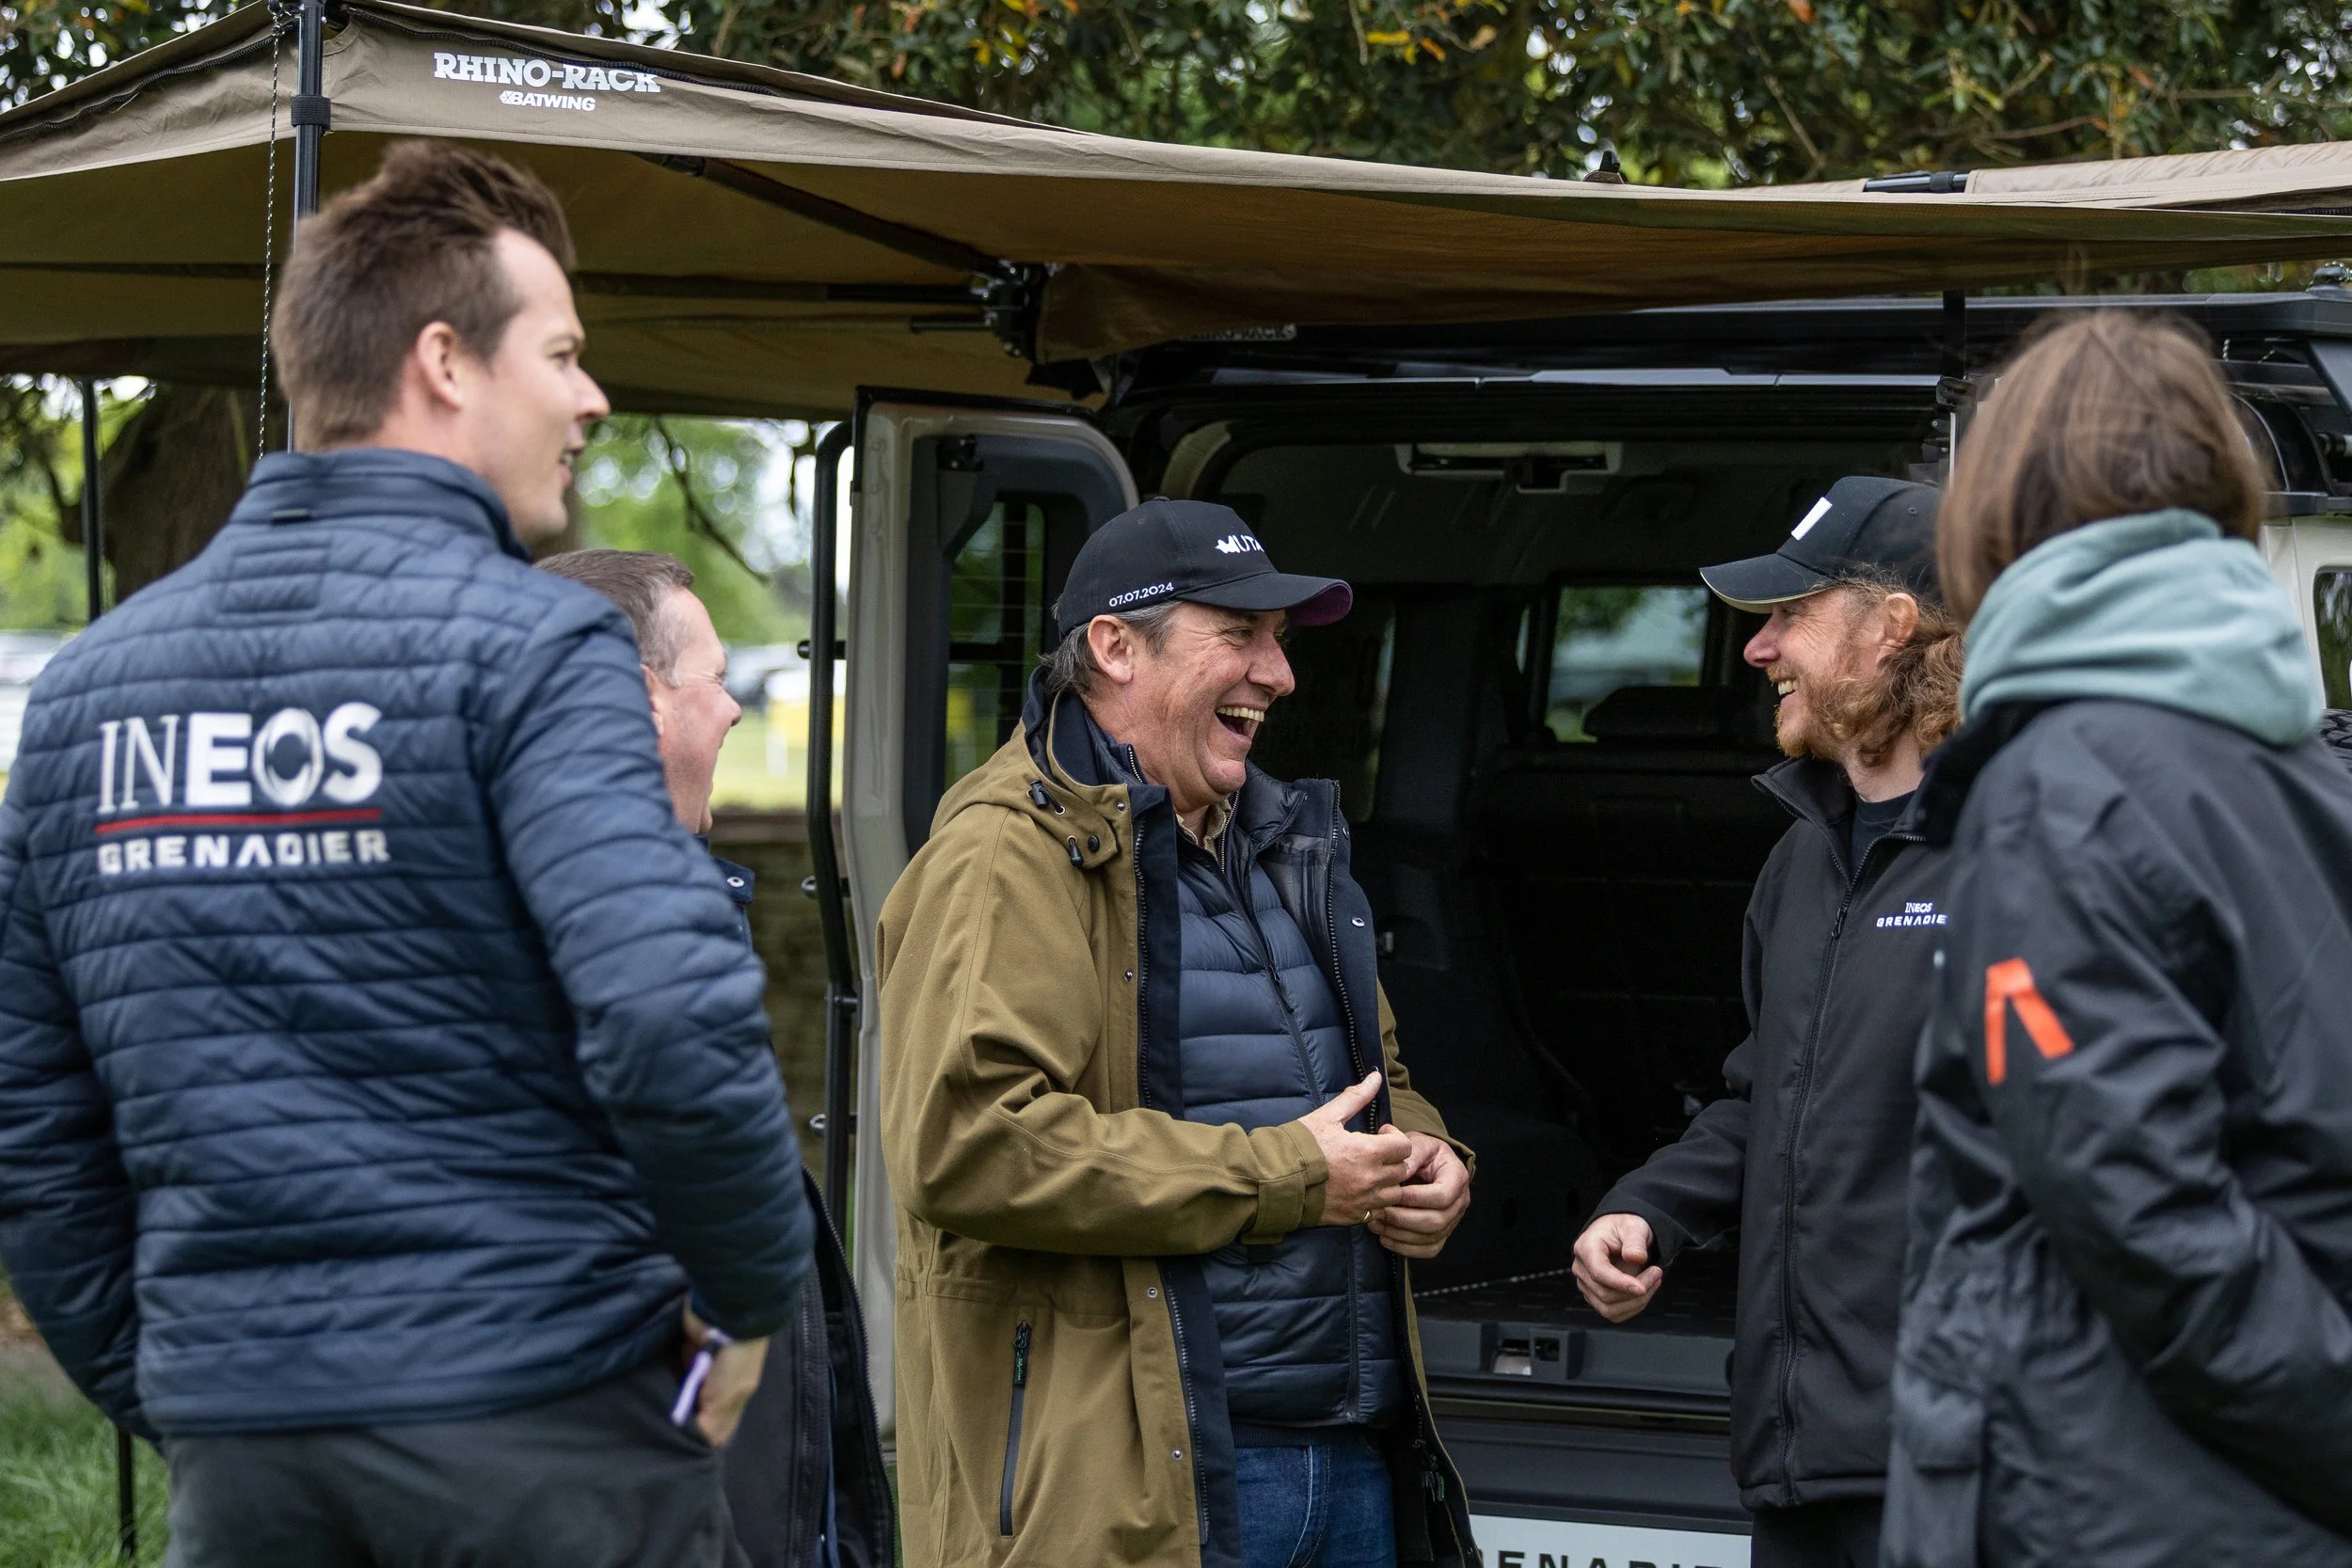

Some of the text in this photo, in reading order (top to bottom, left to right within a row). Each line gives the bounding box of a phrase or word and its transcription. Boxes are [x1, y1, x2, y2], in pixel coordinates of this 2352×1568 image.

[434, 52, 660, 93] RHINO-RACK
[510, 91, 596, 112] BATWING
[1108, 581, 1174, 607] 07.07.2024
[96, 702, 383, 815] INEOS
[97, 829, 391, 875] GRENADIER
[1876, 913, 1948, 927] GRENADIE
[1904, 902, 1932, 913] INEOS
